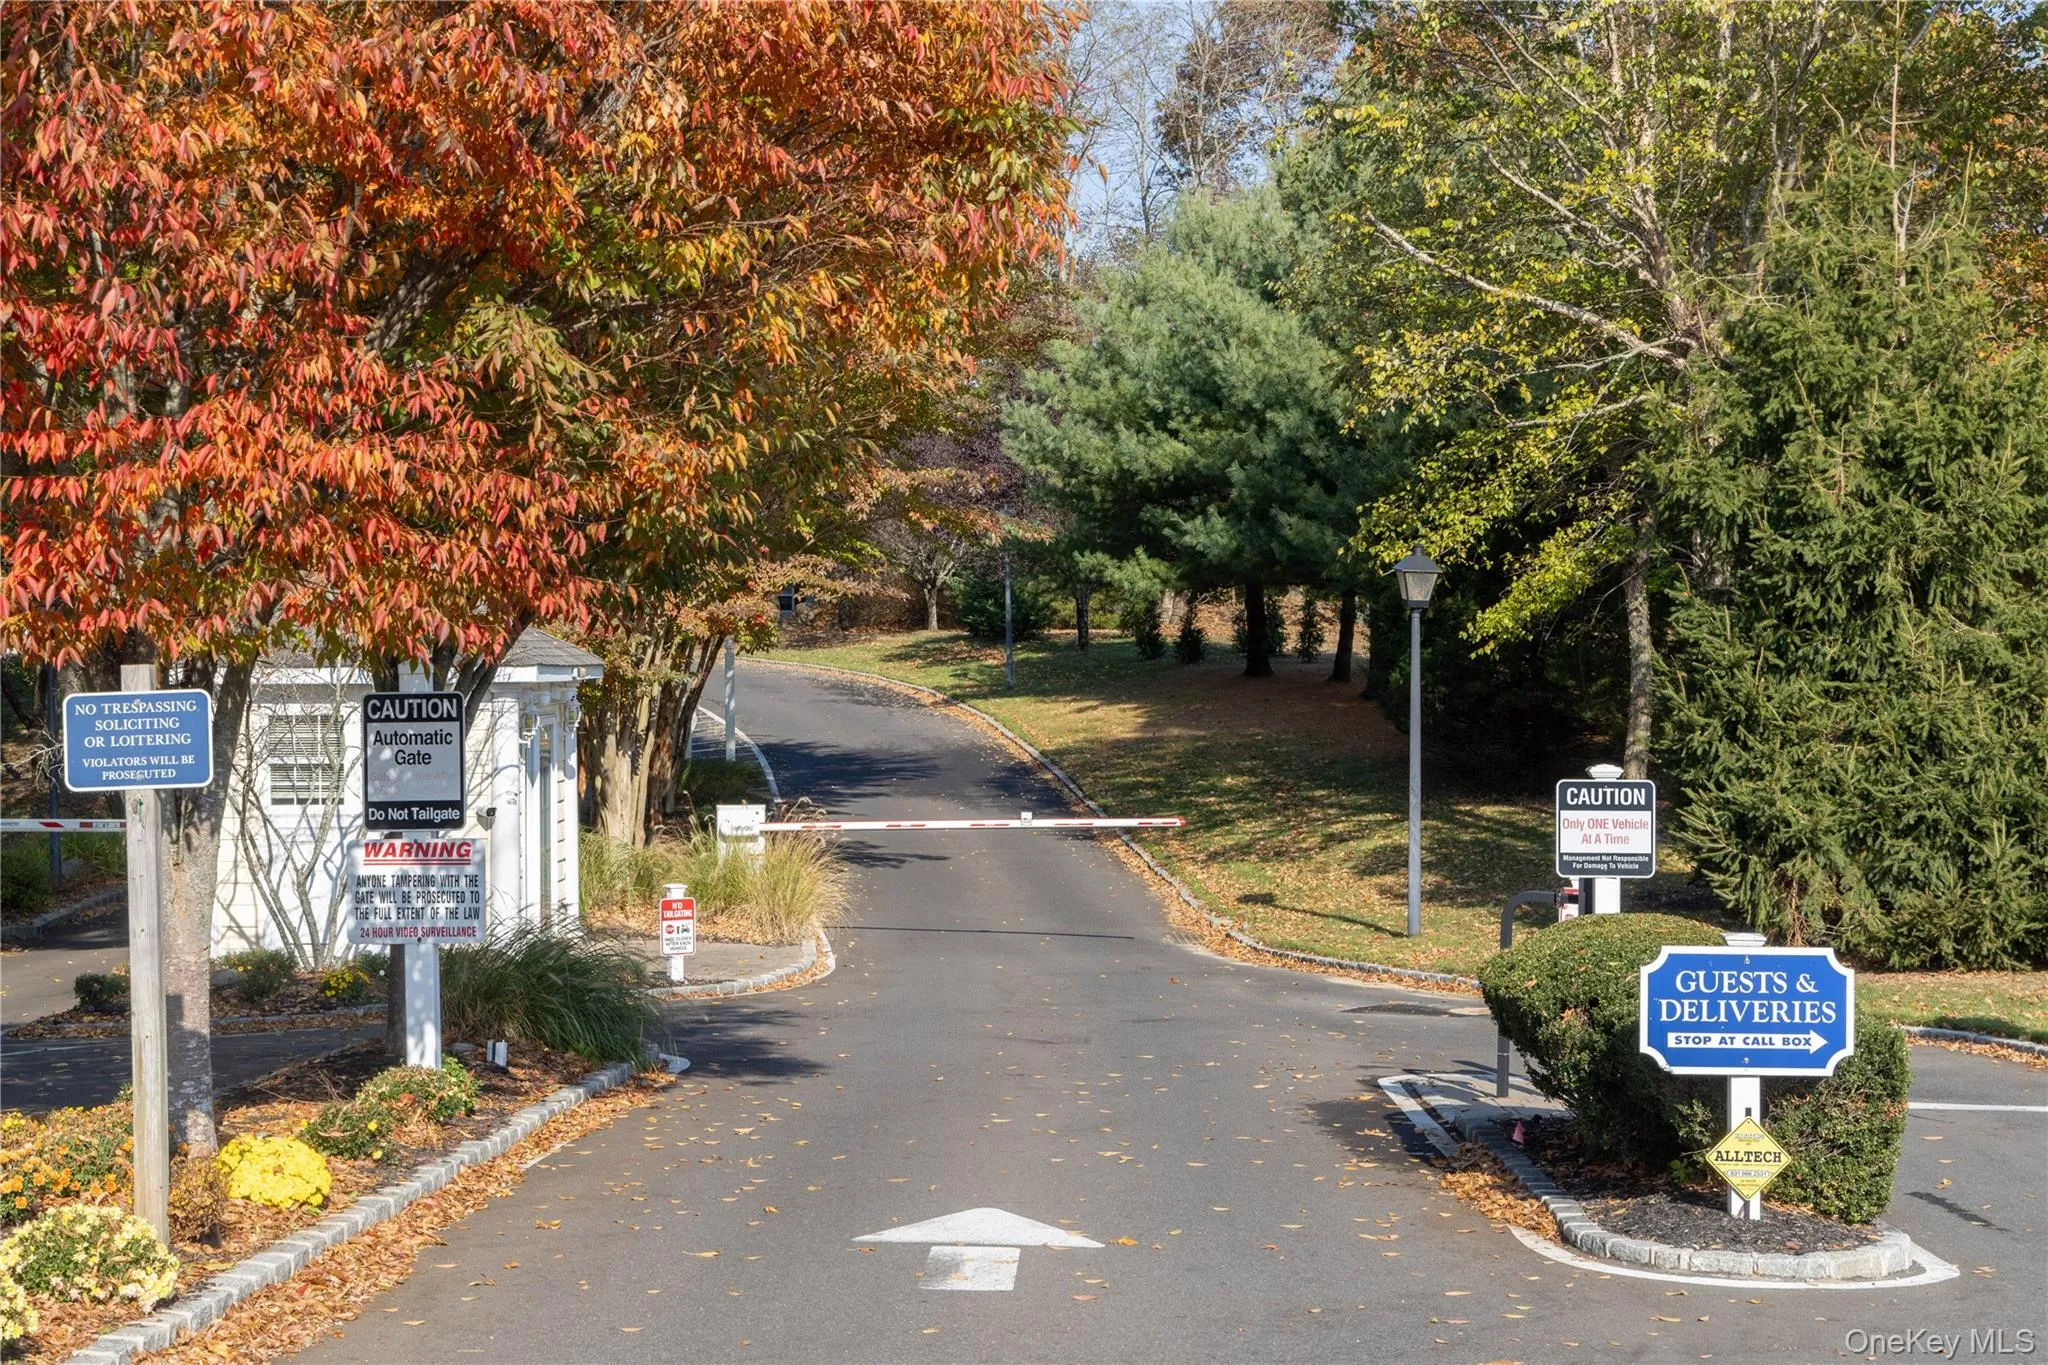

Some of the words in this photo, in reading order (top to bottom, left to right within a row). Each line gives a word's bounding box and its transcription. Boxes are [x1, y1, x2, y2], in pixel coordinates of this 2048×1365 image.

[75, 704, 96, 715] NO
[101, 700, 197, 714] TRESPASSING
[368, 698, 456, 719] CAUTION
[95, 717, 180, 731] SOLICITING
[84, 736, 105, 748] OR
[110, 734, 192, 747] LOITERING
[373, 730, 453, 746] Automatic
[82, 757, 147, 768] VIOLATORS
[150, 756, 178, 765] WILL
[182, 755, 195, 764] BE
[395, 750, 432, 765] Gate
[102, 769, 176, 780] PROSECUTED
[1566, 788, 1646, 805] CAUTION
[368, 808, 385, 820] Do
[388, 808, 408, 820] Not
[411, 808, 460, 822] Tailgate
[1562, 818, 1584, 831] Only
[1588, 818, 1608, 830] ONE
[1612, 818, 1648, 830] Vehicle
[1581, 834, 1592, 844] At
[1594, 834, 1602, 844] A
[1604, 834, 1630, 844] Time
[364, 842, 472, 858] WARNING
[356, 875, 386, 887] ANYONE
[392, 875, 435, 887] TAMPERING
[440, 875, 460, 887] WITH
[464, 875, 478, 887] THE
[355, 891, 374, 904] GATE
[379, 891, 397, 904] WILL
[402, 891, 411, 904] BE
[416, 891, 465, 904] PROSECUTED
[470, 891, 480, 904] TO
[355, 907, 369, 920] THE
[374, 907, 392, 920] FULL
[397, 907, 424, 920] EXTENT
[430, 907, 440, 920] OF
[446, 907, 458, 920] THE
[464, 907, 480, 920] LAW
[360, 928, 370, 938] 24
[372, 928, 394, 938] HOUR
[396, 927, 418, 938] VIDEO
[420, 926, 476, 938] SURVEILLANCE
[1676, 970, 1788, 994] GUESTS
[1796, 974, 1818, 993] &
[1659, 999, 1836, 1024] DELIVERIES
[1674, 1036, 1712, 1046] STOP
[1718, 1036, 1736, 1046] AT
[1742, 1037, 1775, 1046] CALL
[1782, 1037, 1812, 1046] BOX
[1715, 1150, 1782, 1162] ALLTECH
